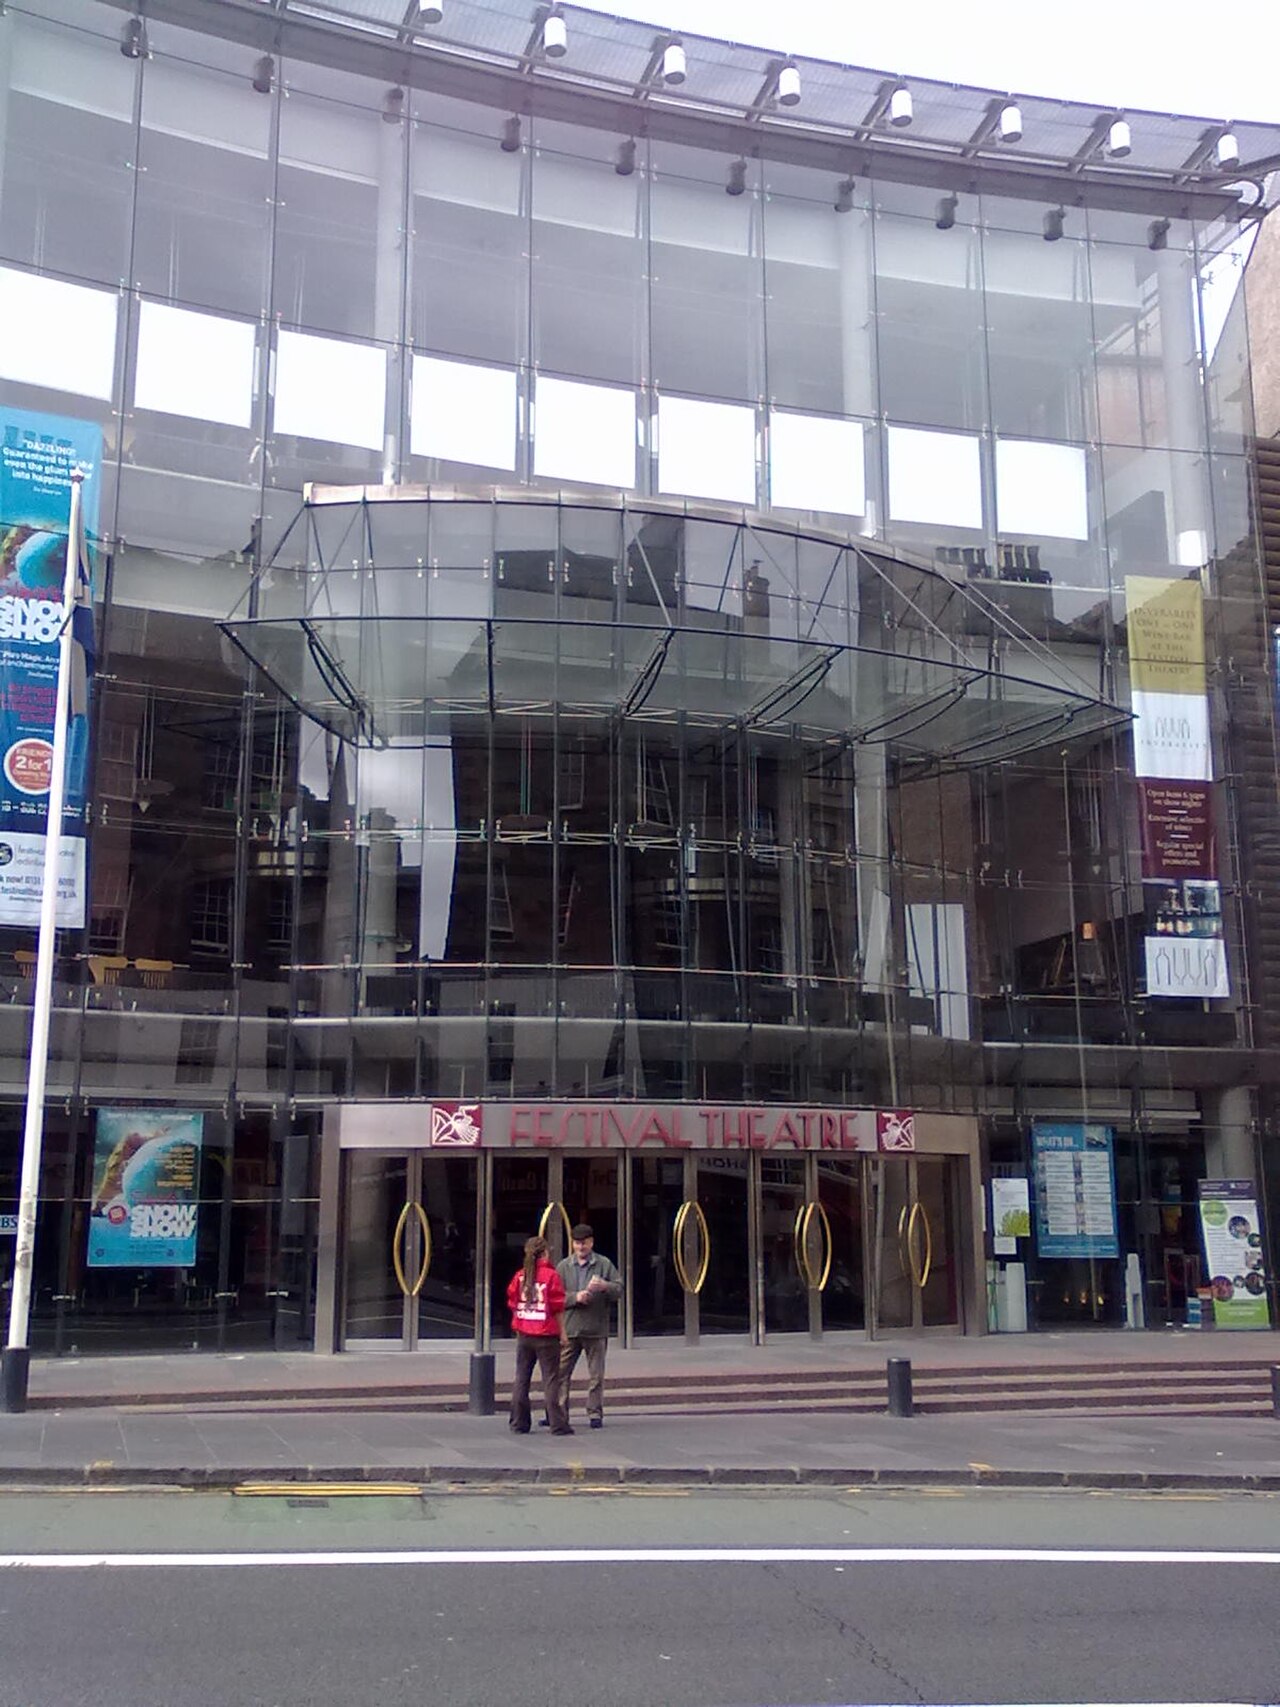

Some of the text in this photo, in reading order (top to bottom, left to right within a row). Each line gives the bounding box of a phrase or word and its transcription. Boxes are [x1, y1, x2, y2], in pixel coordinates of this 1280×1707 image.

[0, 594, 64, 621] SNO
[0, 617, 63, 643] SHO
[15, 755, 52, 772] 2 for 1
[1147, 789, 1165, 798] Open
[510, 1106, 860, 1149] FESTIVAL THEATRE
[131, 1204, 196, 1223] SNOW
[130, 1218, 196, 1240] SHOW
